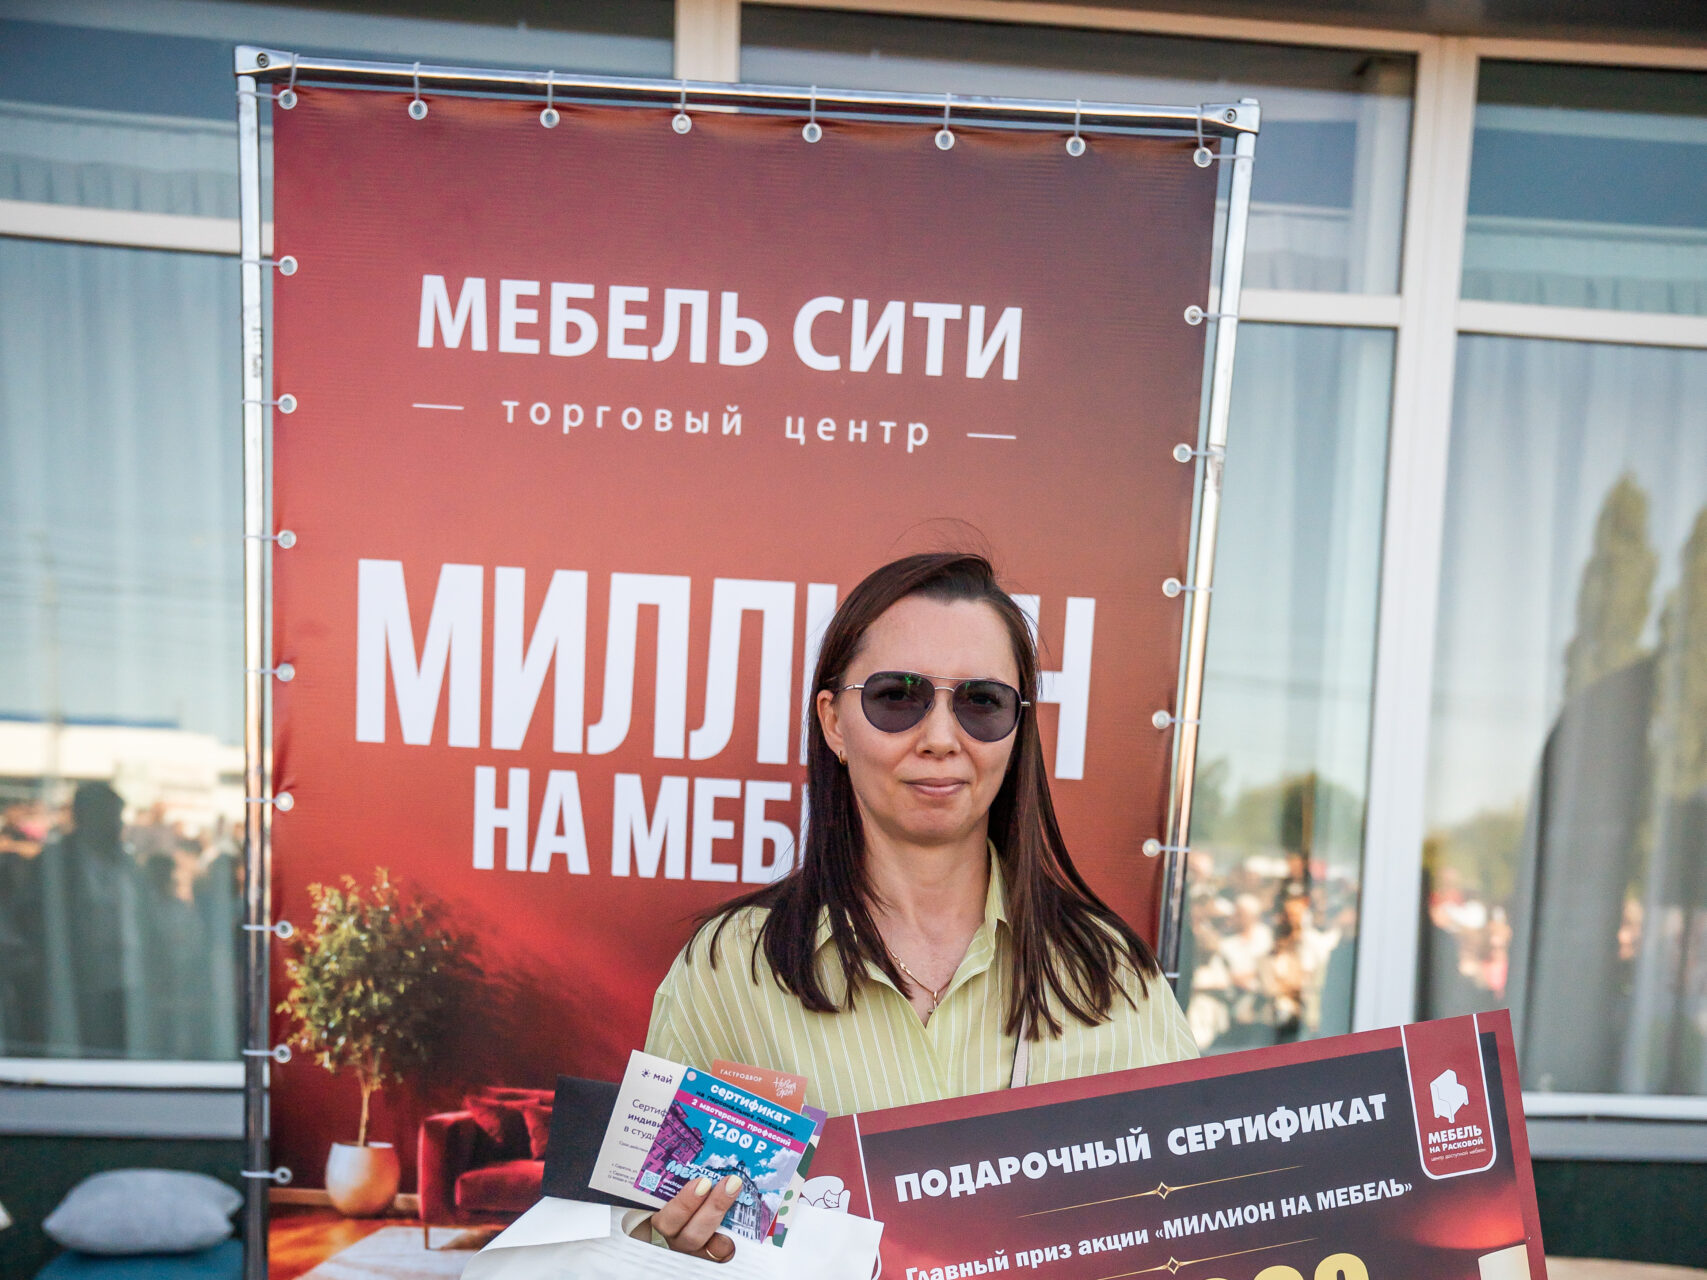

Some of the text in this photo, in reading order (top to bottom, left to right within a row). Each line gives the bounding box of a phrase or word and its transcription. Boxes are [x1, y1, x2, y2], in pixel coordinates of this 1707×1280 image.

[417, 274, 1023, 381] МЕБЕЛЬ СИТИ
[501, 400, 929, 453] торговый центр
[356, 558, 1096, 781] МИЛЛН
[473, 766, 808, 884] НА МЕБ
[653, 1073, 673, 1085] май
[720, 1068, 763, 1083] ГАСТРОДВОР
[691, 1098, 793, 1146] 2 мастерские профессий
[710, 1084, 791, 1125] сертификат
[707, 1118, 753, 1149] 1200
[894, 1093, 1387, 1203] ПОДАРОЧНЫЙ СЕРТИФИКАТ
[1428, 1125, 1482, 1145] МЕБЕЛЬ
[1015, 1243, 1072, 1269] приз
[1078, 1229, 1149, 1256] акции
[1155, 1202, 1276, 1240] «МИЛЛИОН
[1280, 1195, 1312, 1218] НА
[1316, 1178, 1412, 1211] МЕБЕЛЬ»
